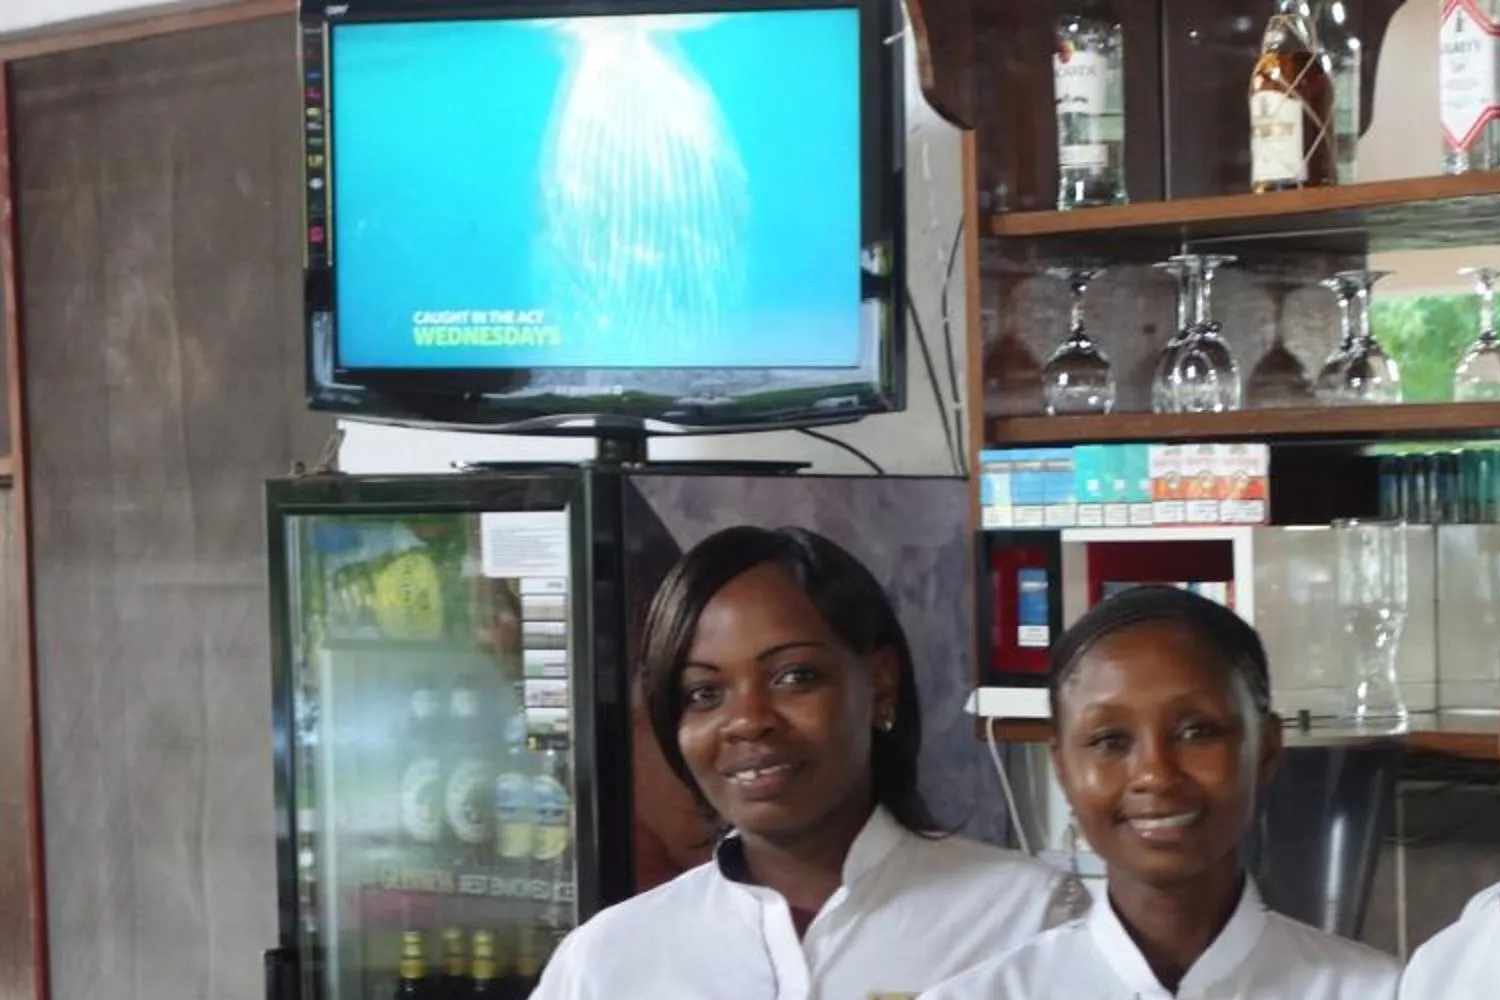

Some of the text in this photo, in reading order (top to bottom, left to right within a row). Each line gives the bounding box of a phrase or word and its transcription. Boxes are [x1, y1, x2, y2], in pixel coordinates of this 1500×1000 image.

[414, 310, 469, 324] CAUGHT
[489, 311, 515, 324] THE
[516, 310, 545, 324] ACT
[414, 326, 561, 346] WEDNESDAYS
